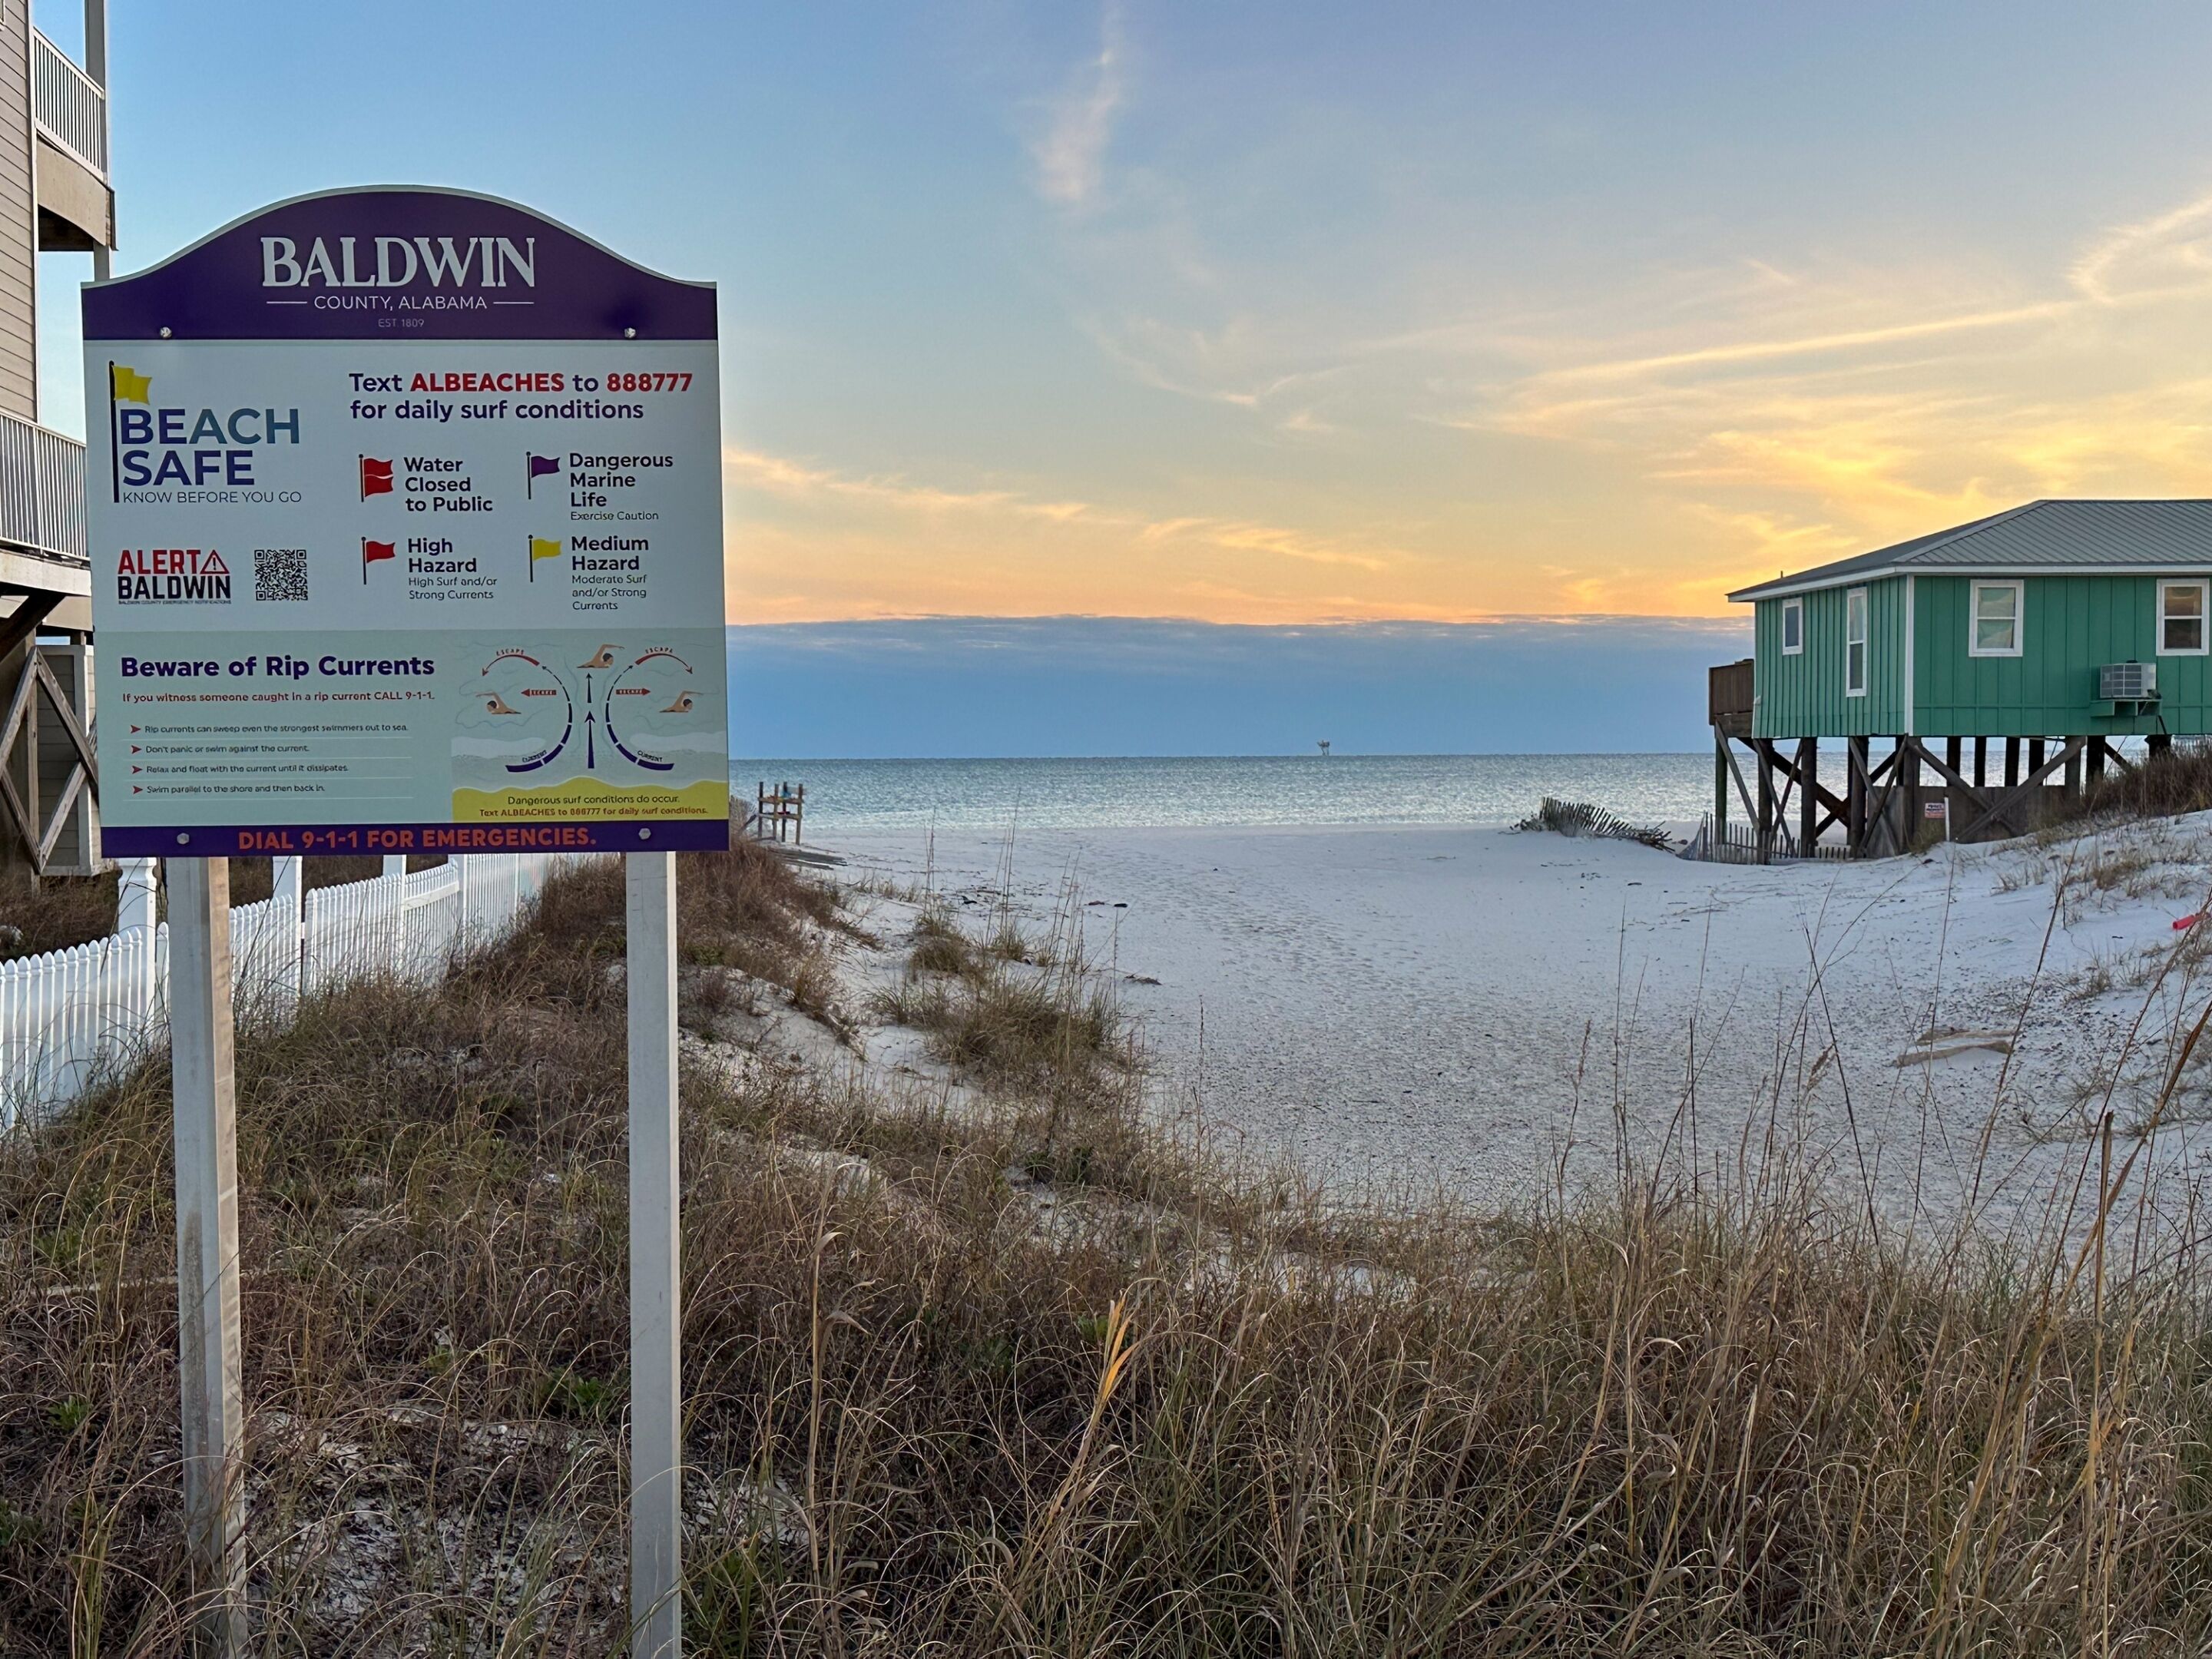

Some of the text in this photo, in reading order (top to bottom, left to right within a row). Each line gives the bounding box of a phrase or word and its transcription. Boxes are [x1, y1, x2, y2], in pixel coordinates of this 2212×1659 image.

[260, 237, 535, 286] BALDWIN
[314, 296, 487, 311] COUNTY, ALABAMA
[402, 318, 425, 328] 1809
[349, 373, 692, 392] Text ALBEACHES to 888777
[350, 399, 644, 422] for daily surf conditions
[120, 408, 300, 445] BEACH
[122, 450, 255, 486] SAFE
[404, 457, 463, 472] Water
[570, 452, 674, 470] Dangerous
[406, 477, 471, 492] Closed
[570, 472, 636, 487] Marine
[123, 492, 302, 503] KNOW BEFORE YOU GO
[406, 495, 493, 512] to Public
[571, 492, 607, 507] Life
[571, 511, 659, 521] Exercise Caution
[408, 538, 453, 555] High
[571, 535, 649, 551] Medium
[118, 549, 201, 575] ALERT
[409, 558, 477, 572] Hazard
[572, 555, 640, 571] Hazard
[409, 577, 498, 588] High Surf and/or
[572, 575, 647, 584] Moderate Surf
[118, 576, 230, 599] BALDWIN
[572, 588, 647, 598] and/or Strong
[409, 590, 494, 601] Strong Currents
[572, 601, 618, 611] Currents
[121, 654, 435, 680] Beware of Rip Currents
[123, 694, 131, 702] If
[134, 694, 153, 704] you
[157, 693, 196, 702] witness
[252, 693, 289, 703] caught
[292, 692, 302, 700] in
[314, 692, 328, 702] rip
[332, 692, 371, 700] current
[144, 725, 160, 733] Rip
[171, 745, 192, 753] panic
[229, 745, 259, 753] against
[171, 786, 201, 794] parallel
[508, 796, 561, 806] Dangerous
[563, 796, 581, 804] surf
[584, 795, 634, 803] conditions
[637, 795, 650, 803] do
[238, 828, 597, 849] DIAL 9-1-1 FOR EMERGENCIES.
